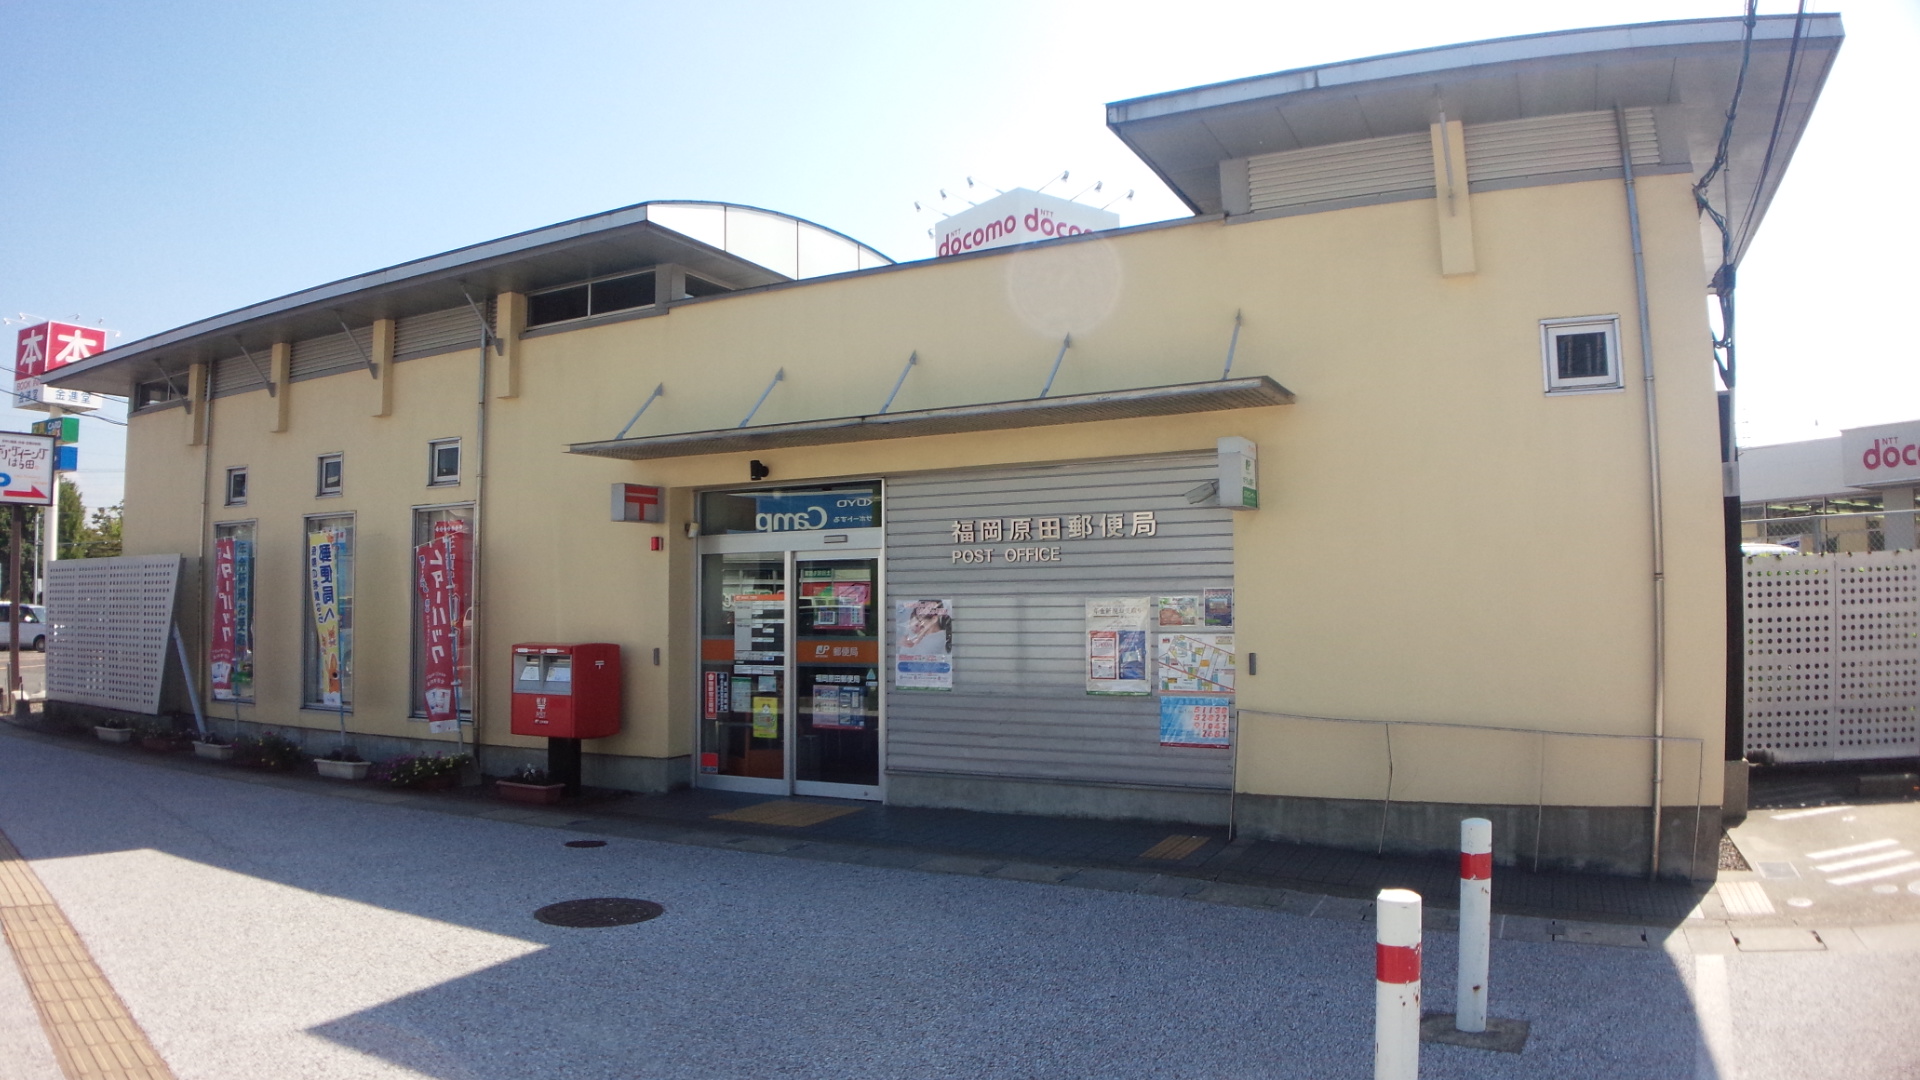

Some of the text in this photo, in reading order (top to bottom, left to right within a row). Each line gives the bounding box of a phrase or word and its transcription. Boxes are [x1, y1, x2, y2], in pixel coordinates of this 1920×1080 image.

[1040, 208, 1054, 217] NTT
[938, 215, 1017, 257] docomo
[20, 329, 44, 374] 本
[55, 329, 97, 363] 本
[16, 380, 31, 391] BOOK
[1881, 436, 1899, 445] NTT
[1863, 439, 1920, 470] doc
[952, 511, 1157, 543] 福岡原田郵便局
[952, 547, 1061, 564] POST OFFICE
[833, 646, 859, 657] 郵便局
